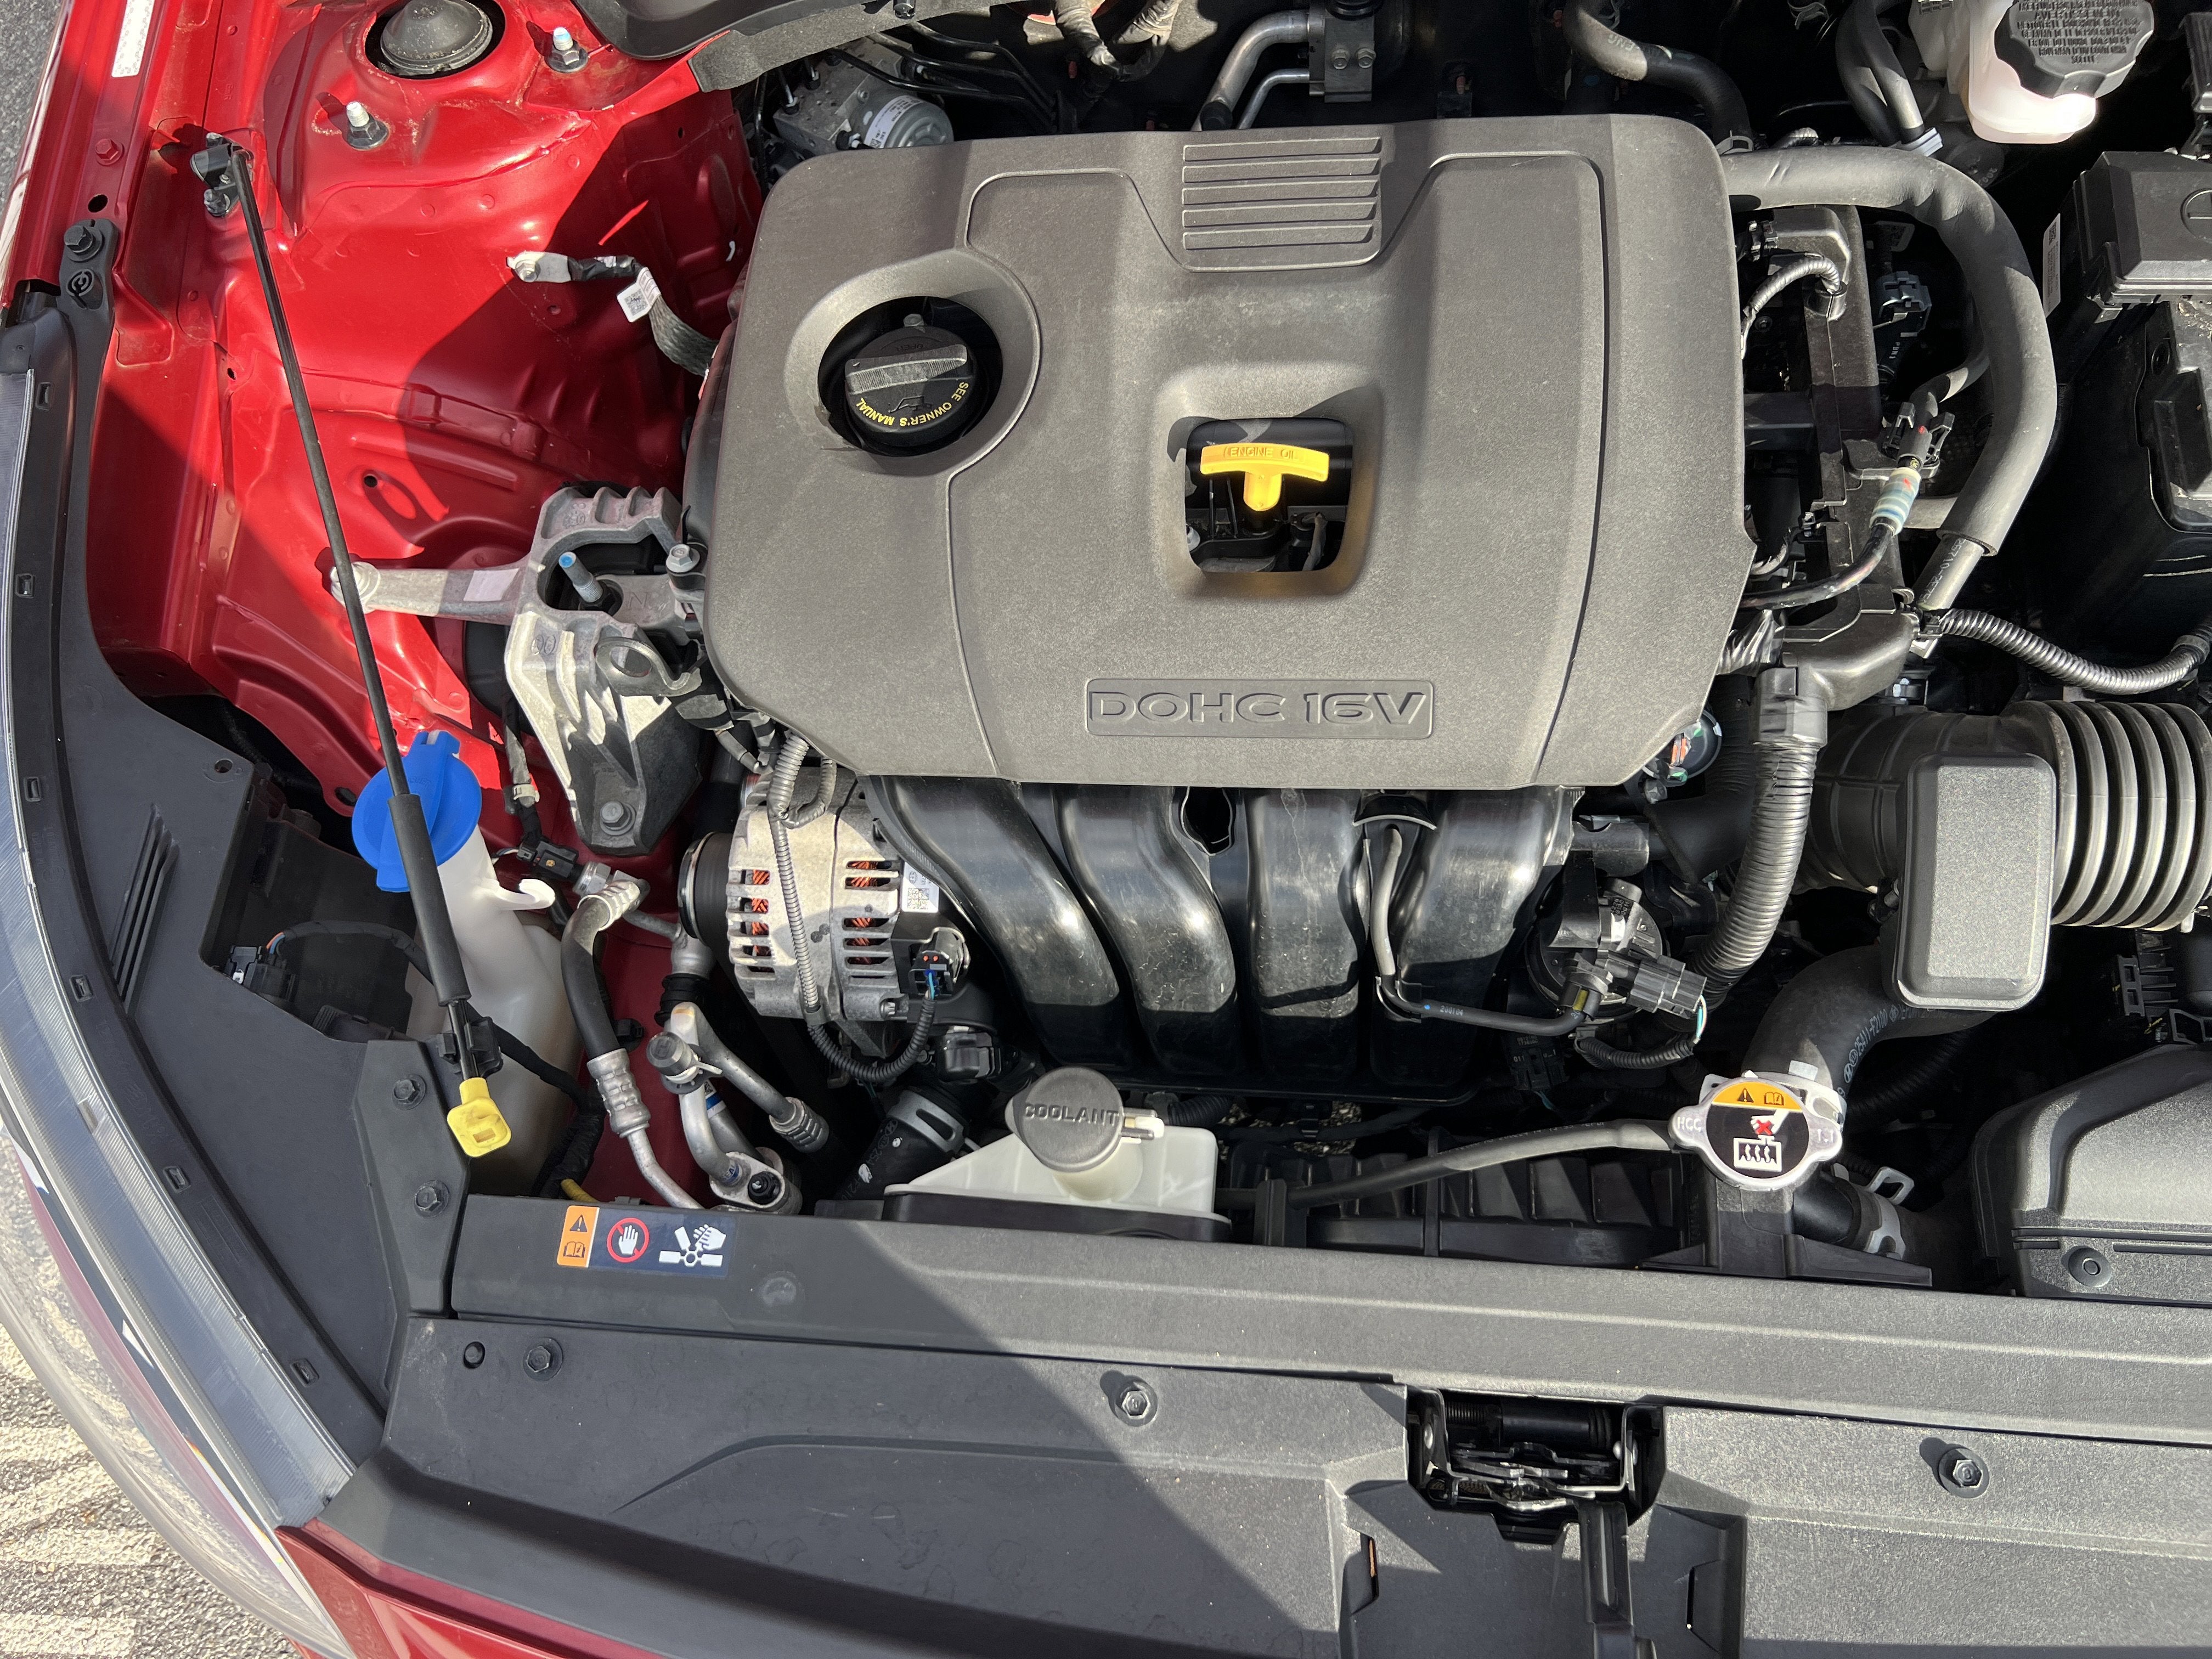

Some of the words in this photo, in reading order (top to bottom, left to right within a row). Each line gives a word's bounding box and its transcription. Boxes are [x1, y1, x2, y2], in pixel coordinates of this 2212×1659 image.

[951, 382, 969, 402] SEE
[856, 397, 895, 426] MANUAL
[899, 402, 952, 427] OWNER'S
[1231, 447, 1273, 458] ENGINE
[1281, 449, 1299, 460] OIL
[1088, 692, 1285, 724] DOHC
[1304, 692, 1427, 725] 16V
[1025, 1102, 1120, 1126] COOLANT
